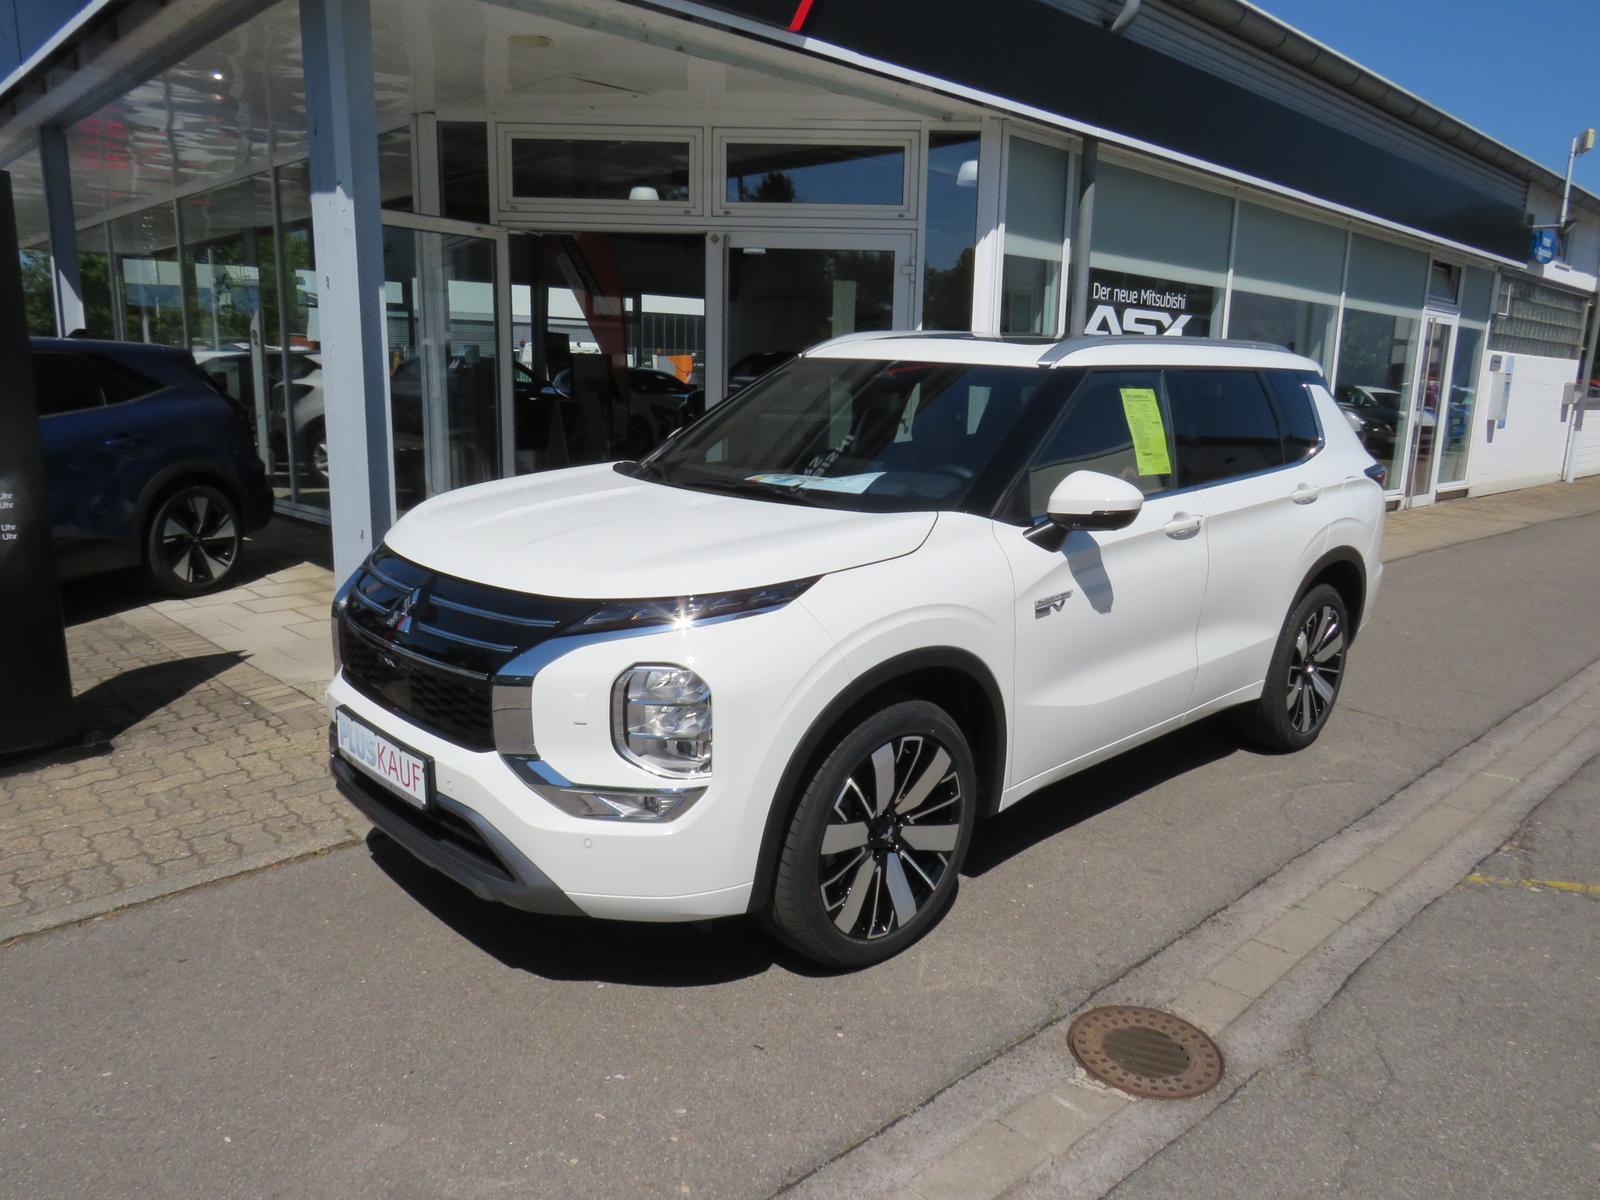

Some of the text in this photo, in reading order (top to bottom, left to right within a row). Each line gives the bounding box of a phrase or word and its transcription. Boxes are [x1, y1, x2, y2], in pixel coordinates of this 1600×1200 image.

[1093, 282, 1187, 309] Der neue Mitsubishi
[1084, 304, 1192, 337] ASX
[0, 501, 14, 509] Uhr
[1, 524, 16, 532] Uhr
[2, 533, 17, 541] Uhr
[339, 718, 420, 791] PLUSKAUF
